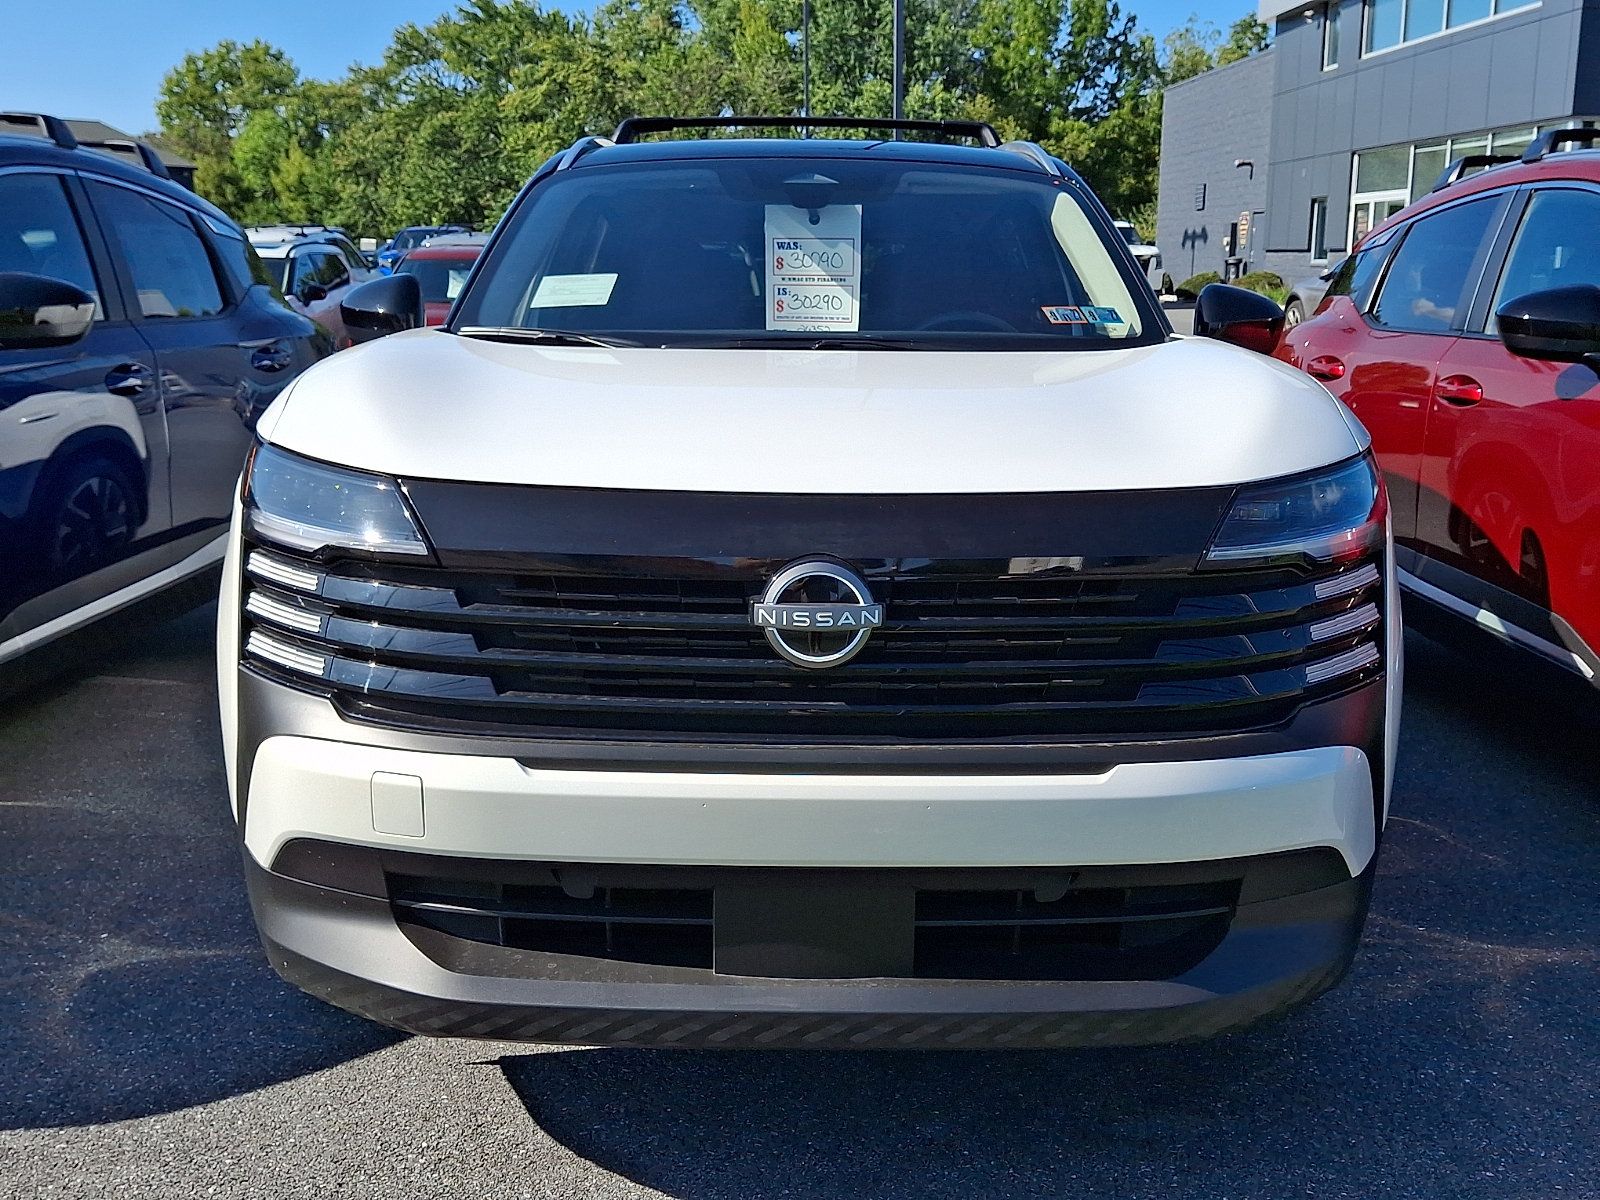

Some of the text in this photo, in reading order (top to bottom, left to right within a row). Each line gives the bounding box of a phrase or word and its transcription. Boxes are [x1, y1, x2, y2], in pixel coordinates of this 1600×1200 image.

[776, 241, 802, 251] WAS:
[777, 287, 791, 296] IS:
[787, 294, 843, 311] 30290
[758, 608, 879, 627] NISSAN
